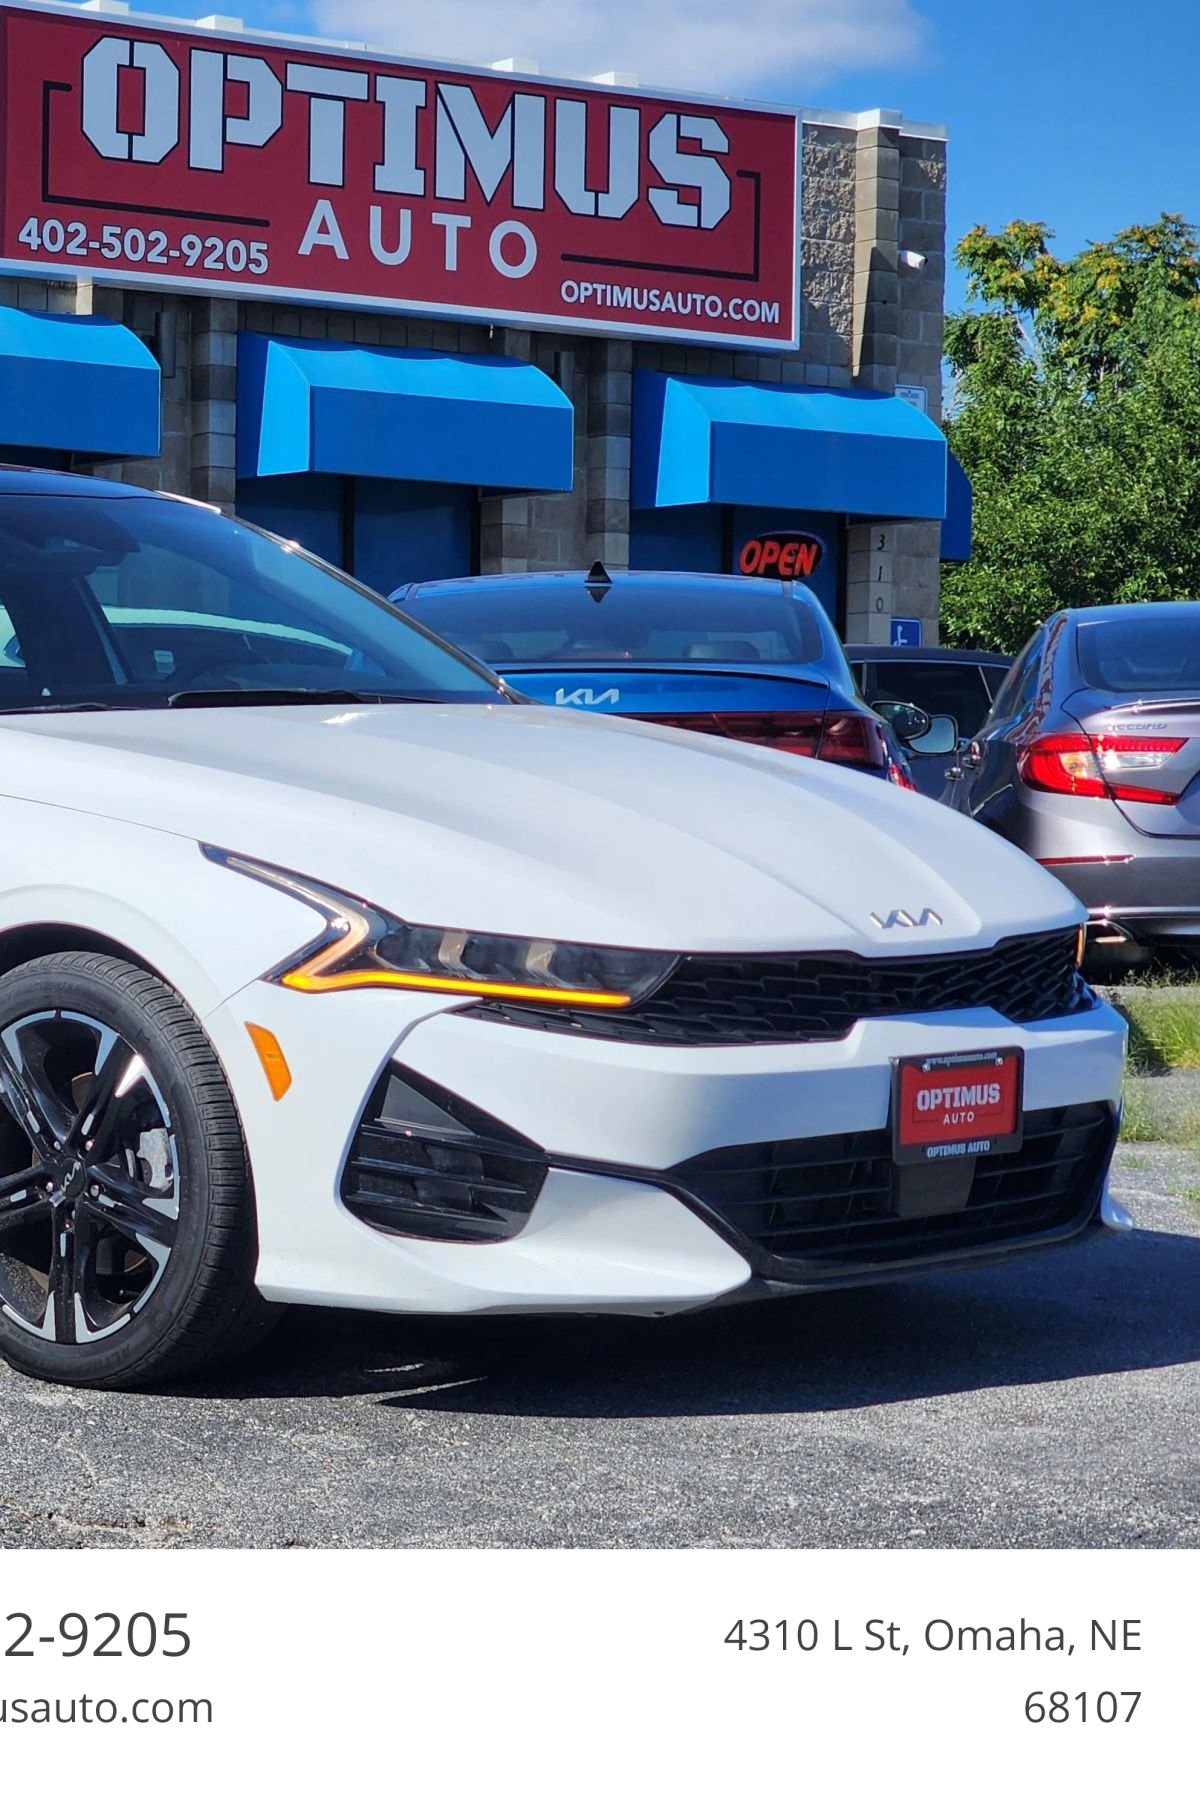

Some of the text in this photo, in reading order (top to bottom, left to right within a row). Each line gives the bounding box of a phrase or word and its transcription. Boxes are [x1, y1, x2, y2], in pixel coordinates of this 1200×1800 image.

[80, 34, 732, 230] OPTIMUS
[18, 216, 269, 275] 402-502-9205
[298, 199, 538, 279] AUTO
[560, 279, 780, 325] OPTIMUSAUTO.COM
[739, 540, 818, 576] OPEN
[917, 1083, 1000, 1111] OPTIMUS
[943, 1111, 975, 1125] AUTO
[927, 1140, 991, 1158] OPTIMUS AUTO
